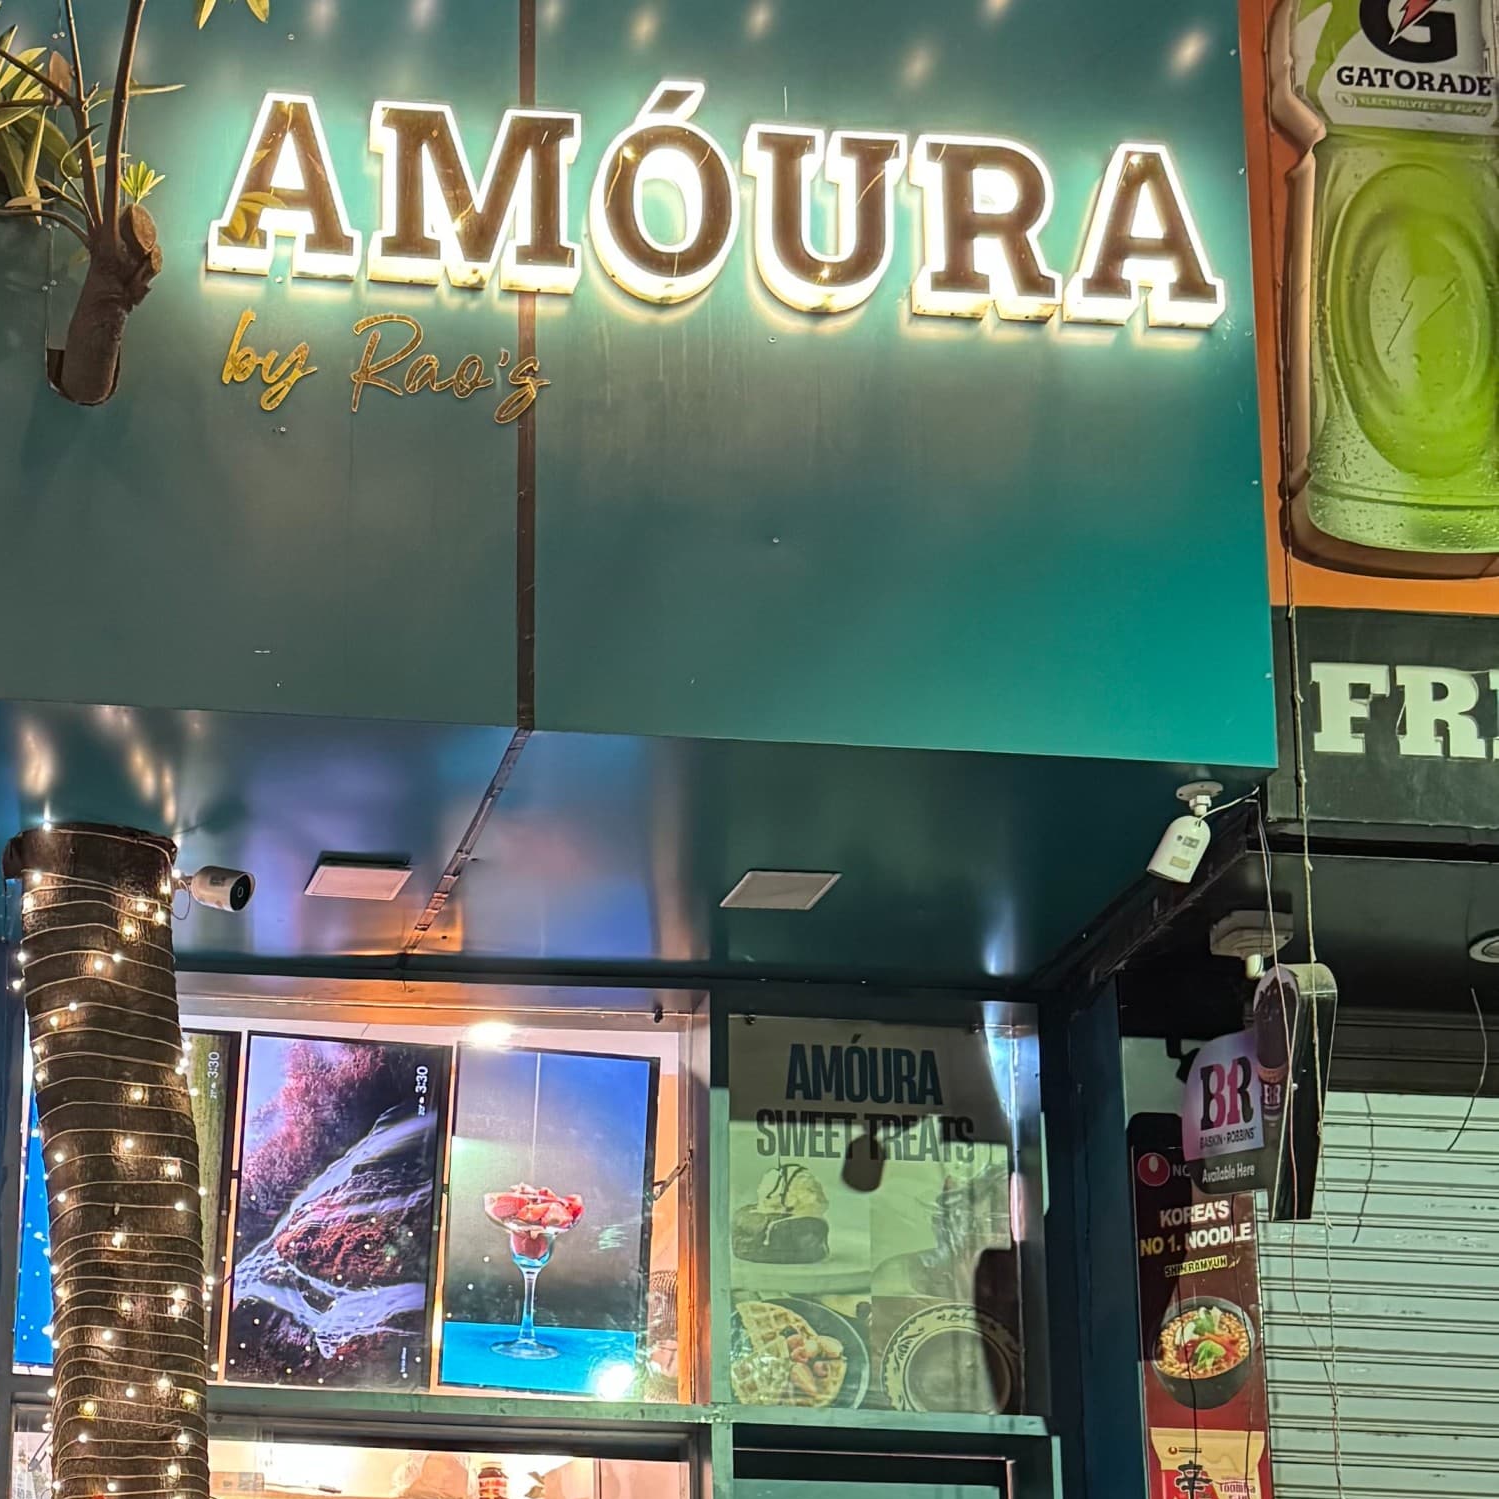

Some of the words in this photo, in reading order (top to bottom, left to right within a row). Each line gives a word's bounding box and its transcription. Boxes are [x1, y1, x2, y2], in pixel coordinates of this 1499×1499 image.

[1337, 65, 1494, 97] GATORADE
[205, 80, 1227, 328] AMÓURA
[221, 308, 320, 411] by
[350, 312, 552, 425] Rao's
[1309, 661, 1499, 760] FR
[207, 1051, 220, 1079] 3:30
[414, 1065, 429, 1095] 3:30
[786, 1034, 943, 1106] AMÓURA
[1199, 1056, 1254, 1132] BR
[756, 1109, 859, 1160] SWEET
[865, 1112, 976, 1164] TREATS
[1202, 1163, 1236, 1185] Available
[1236, 1161, 1255, 1178] Here
[1160, 1200, 1230, 1228] KOREA'S
[1140, 1236, 1164, 1257] NO
[1185, 1222, 1252, 1251] NOODLE
